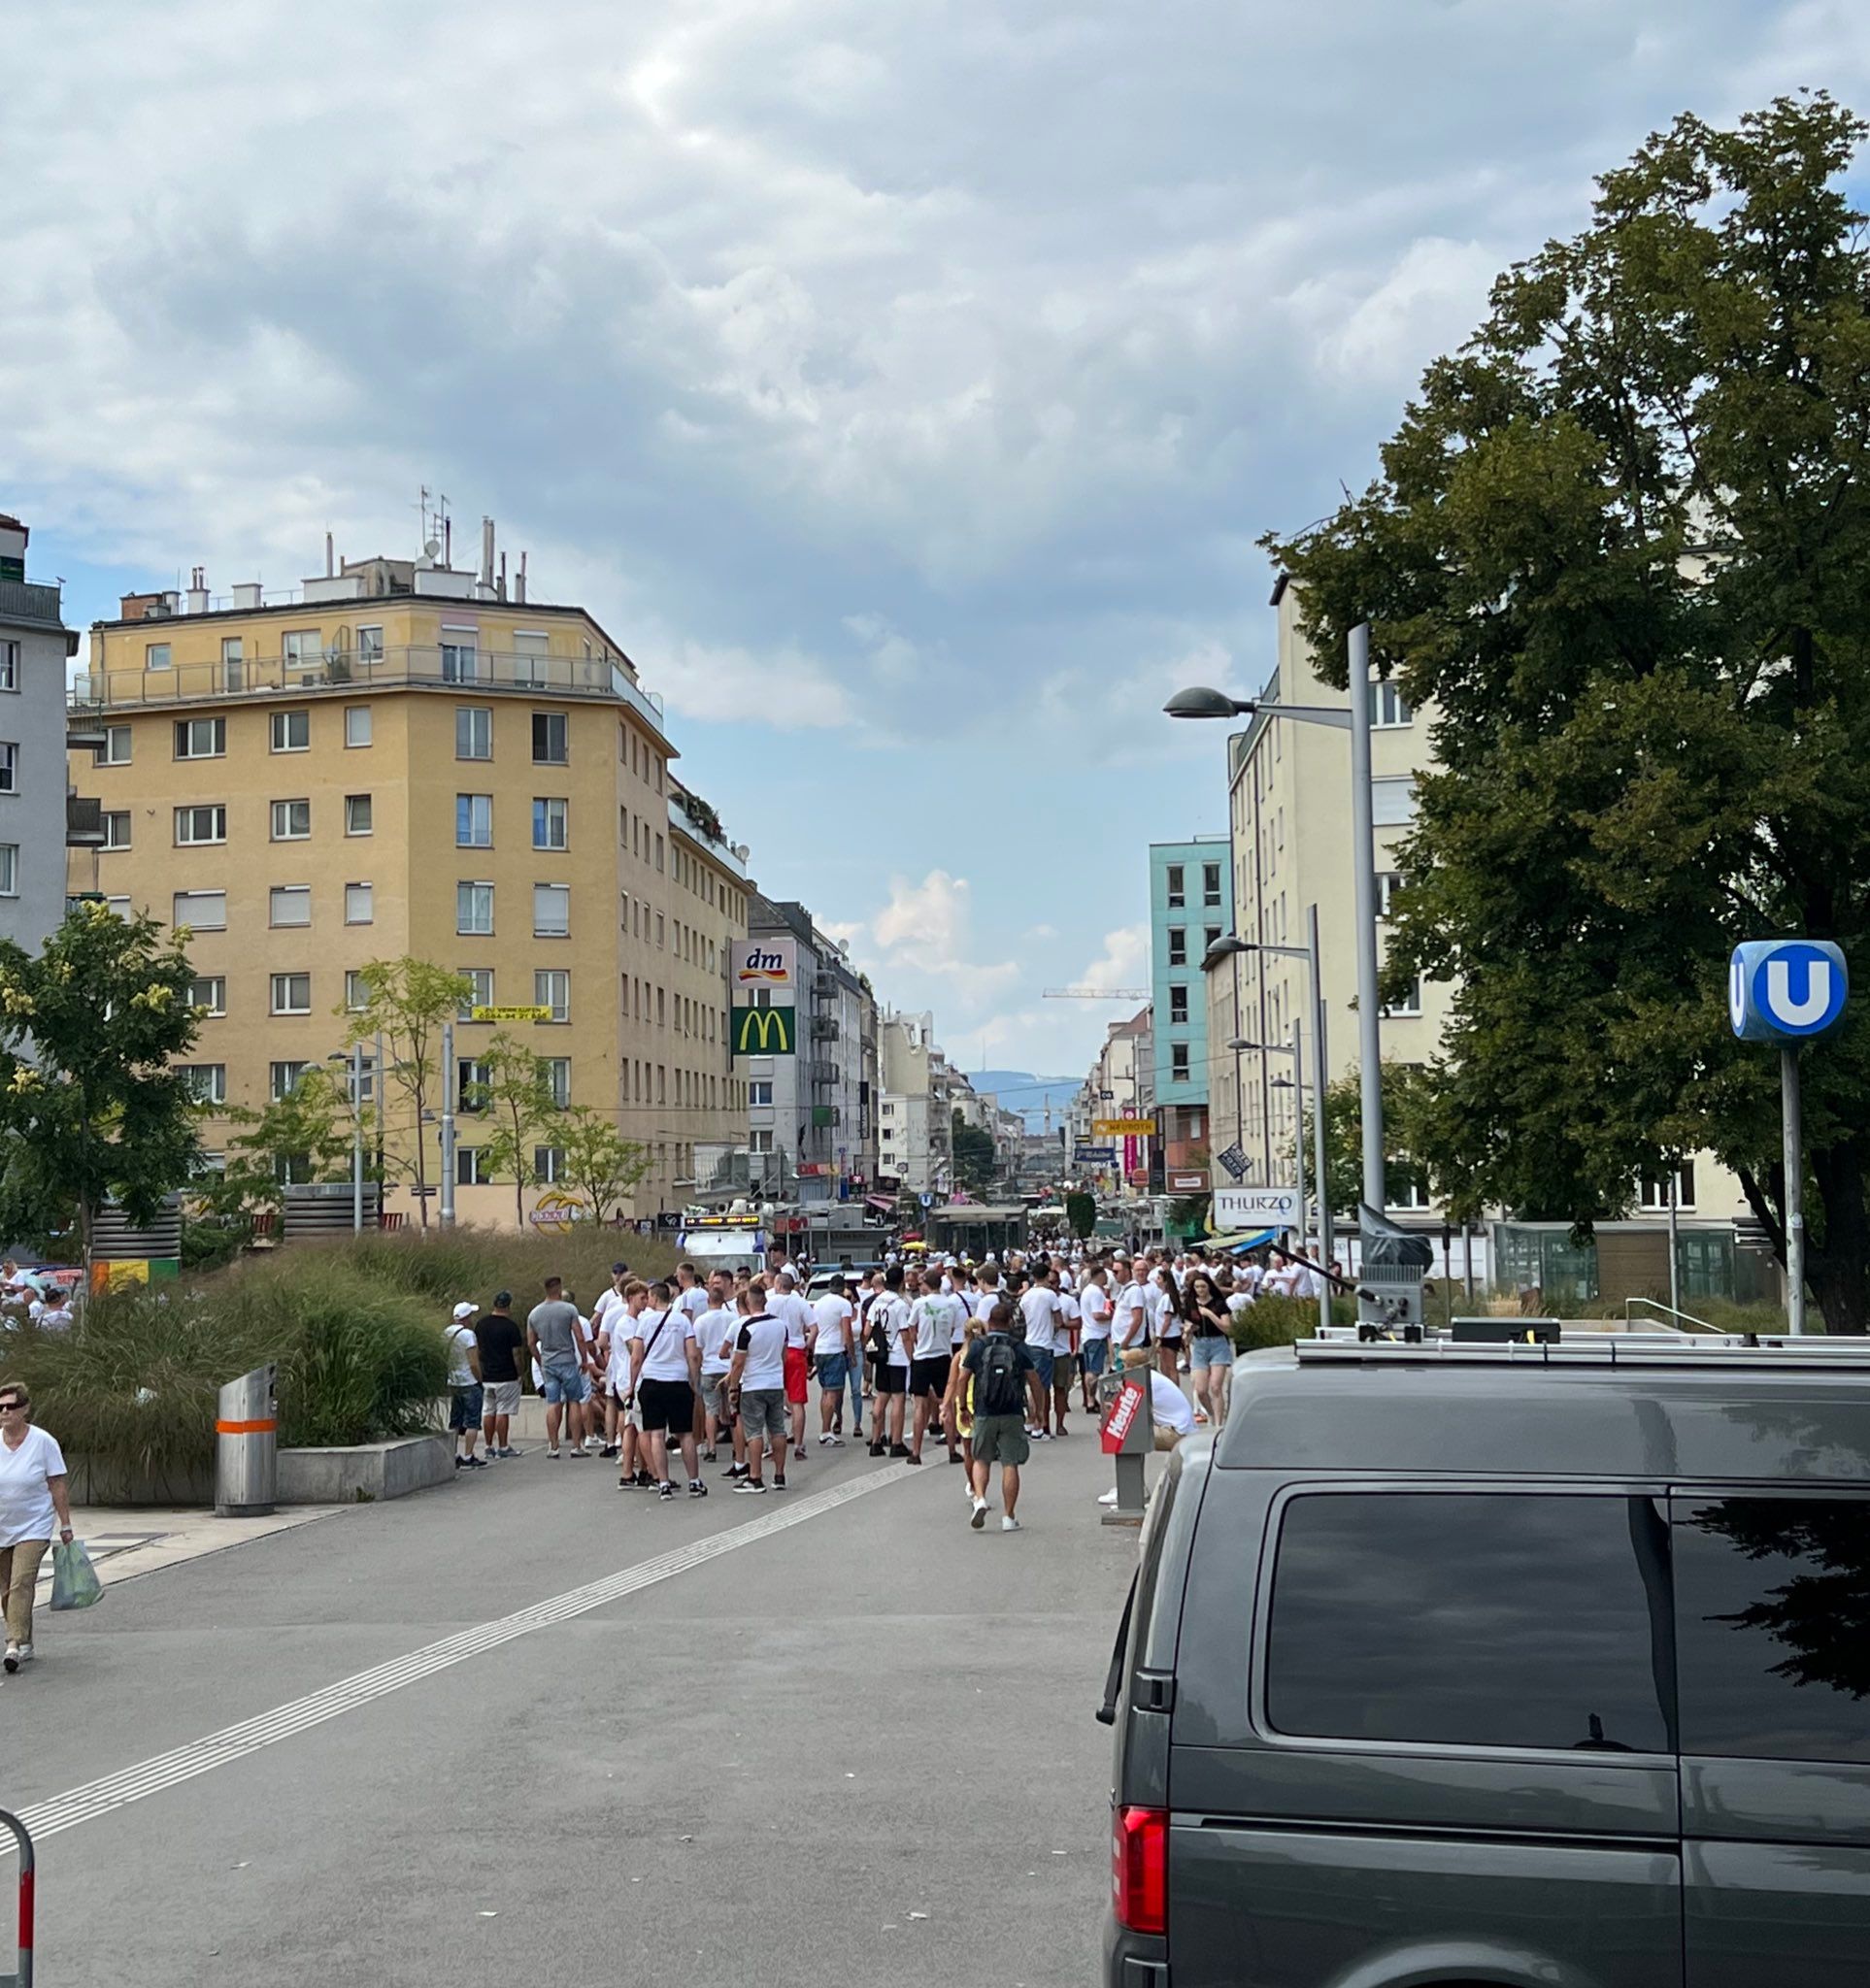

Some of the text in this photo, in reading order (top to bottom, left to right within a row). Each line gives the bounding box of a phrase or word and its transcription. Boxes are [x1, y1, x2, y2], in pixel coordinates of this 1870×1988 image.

[747, 947, 783, 969] dm
[1767, 960, 1830, 1027] U
[1218, 1197, 1292, 1212] THURZO
[1106, 1386, 1138, 1440] Heute
